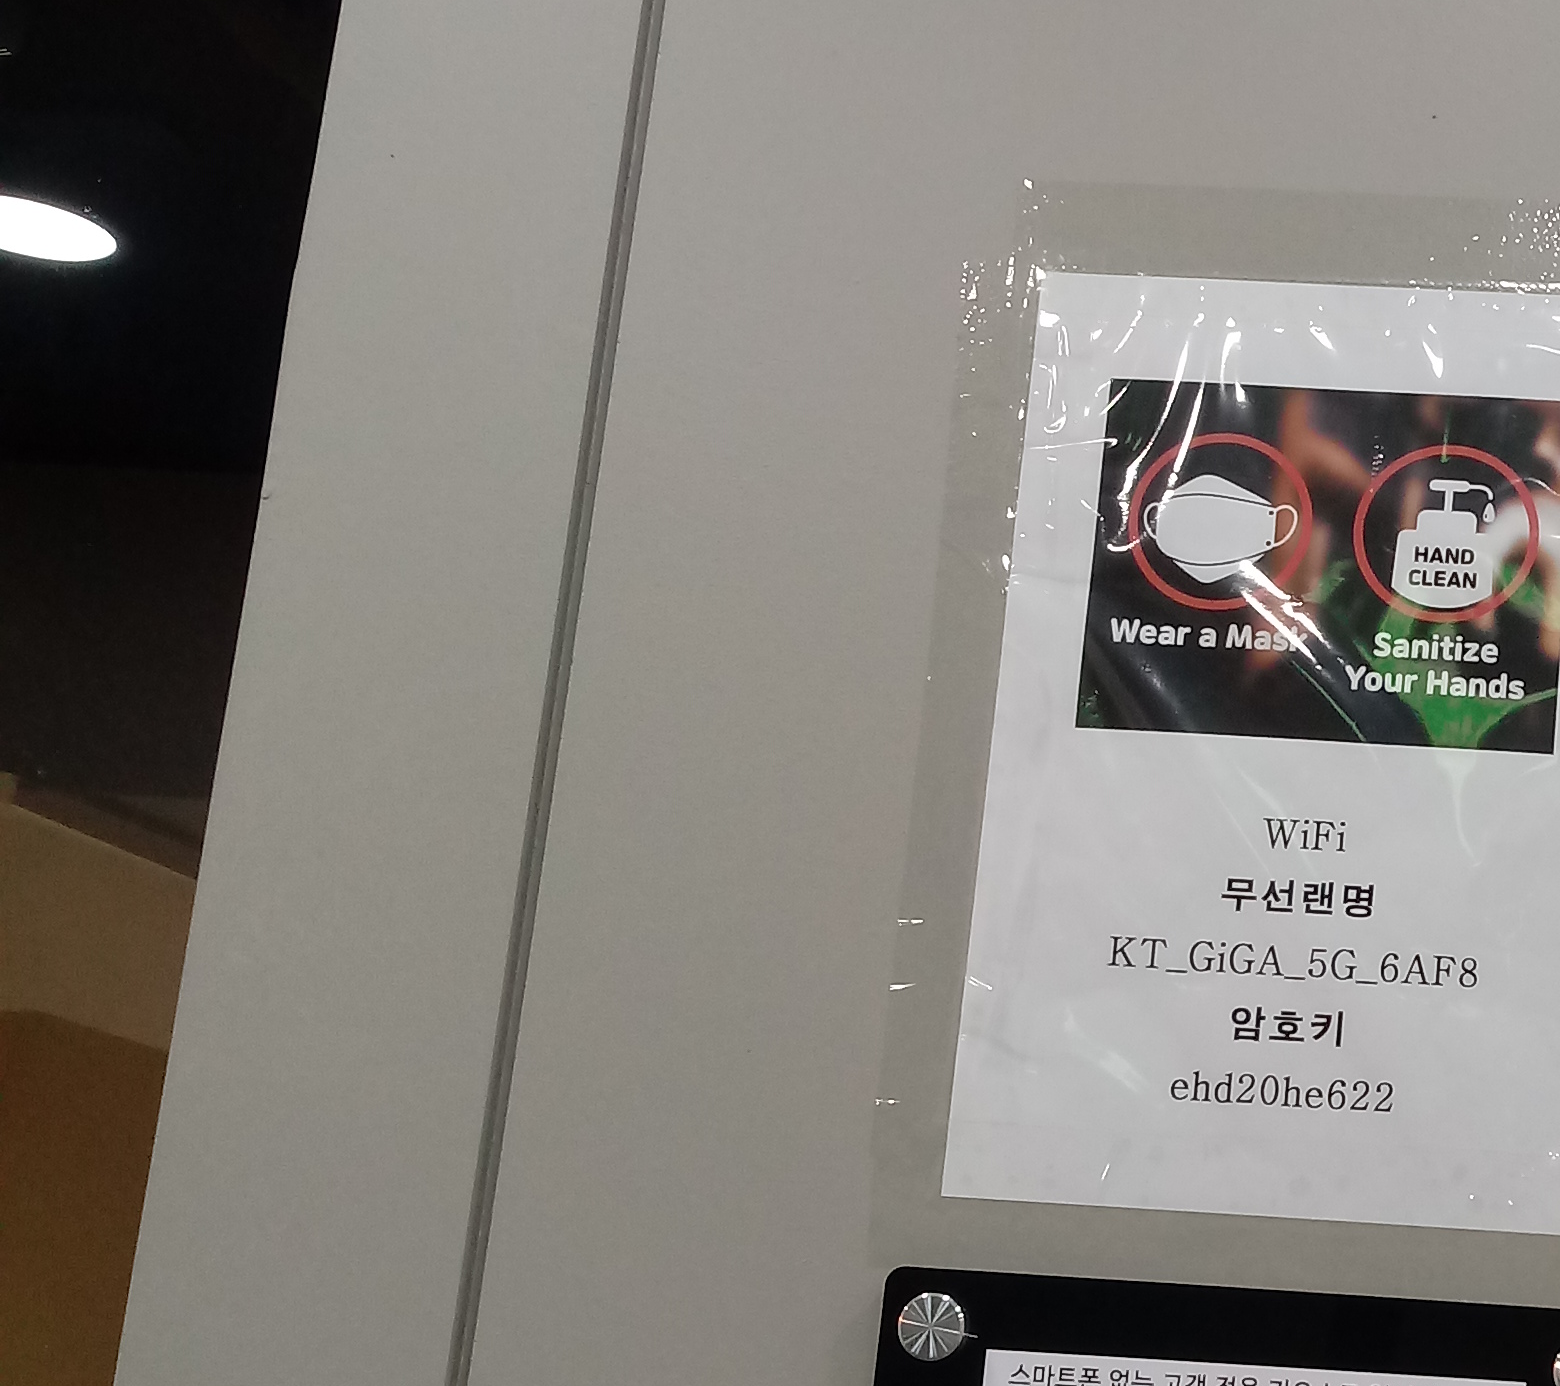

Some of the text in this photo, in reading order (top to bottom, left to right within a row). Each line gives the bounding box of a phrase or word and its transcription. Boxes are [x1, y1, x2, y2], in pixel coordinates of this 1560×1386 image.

[1413, 544, 1475, 567] HAND
[1408, 567, 1479, 591] CLEAN
[1109, 617, 1307, 653] Wear a Mask
[1372, 631, 1500, 665] Sanitize
[1344, 663, 1526, 701] Your Hands
[1263, 817, 1348, 853] WiFi
[1220, 876, 1376, 920] 무선랜명
[1106, 934, 1480, 989] KT_GiGA_5G_6AF8
[1229, 1005, 1347, 1049] 암호키
[1169, 1070, 1396, 1114] ehd20he622
